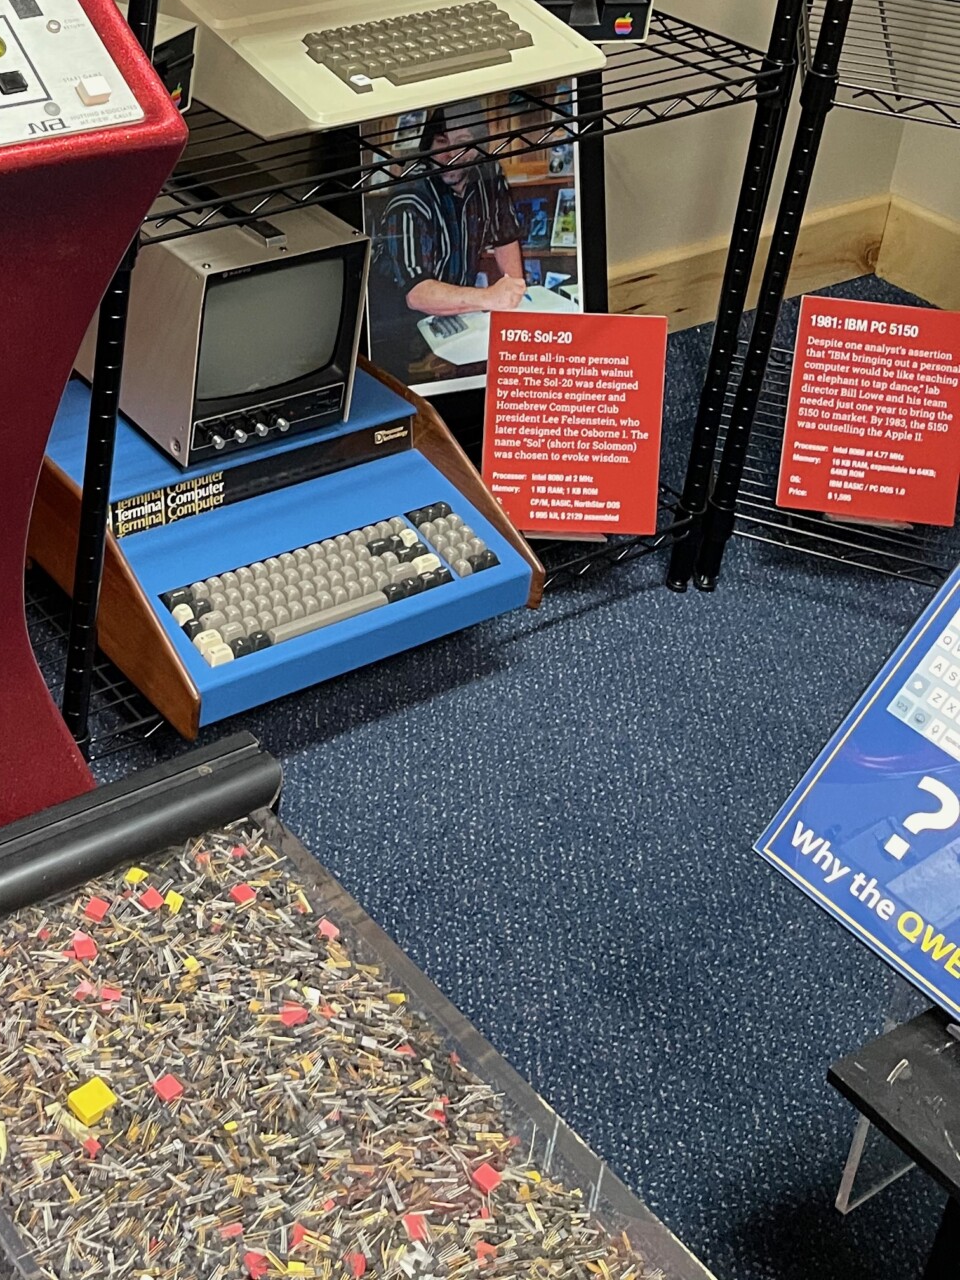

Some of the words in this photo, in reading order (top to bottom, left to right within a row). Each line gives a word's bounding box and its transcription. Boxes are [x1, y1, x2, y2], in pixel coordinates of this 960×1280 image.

[810, 314, 842, 329] 1981:
[844, 317, 868, 331] IBM
[870, 320, 887, 334] PC
[888, 322, 919, 337] 5150
[500, 329, 531, 342] 1976:
[533, 329, 572, 343] Sol-20
[807, 336, 842, 348] Despite
[844, 342, 862, 350] one
[908, 348, 952, 360] assertion
[498, 351, 517, 360] The
[519, 352, 537, 361] first
[540, 352, 586, 363] all-in-one
[587, 356, 629, 365] personal
[806, 347, 824, 357] that
[852, 352, 892, 367] bringing
[498, 365, 544, 375] computer,
[547, 365, 556, 374] in
[566, 366, 598, 377] stylish
[601, 368, 633, 377] walnut
[523, 377, 541, 385] The
[543, 378, 572, 387] Sol-20
[596, 380, 638, 391] designed
[496, 388, 508, 399] by
[510, 388, 562, 399] electronics
[564, 392, 605, 401] engineer
[608, 392, 626, 401] and
[115, 496, 165, 524] Terminal
[166, 482, 224, 509] Computer
[896, 700, 910, 714] 123
[791, 820, 852, 884] Why
[849, 872, 896, 920] the
